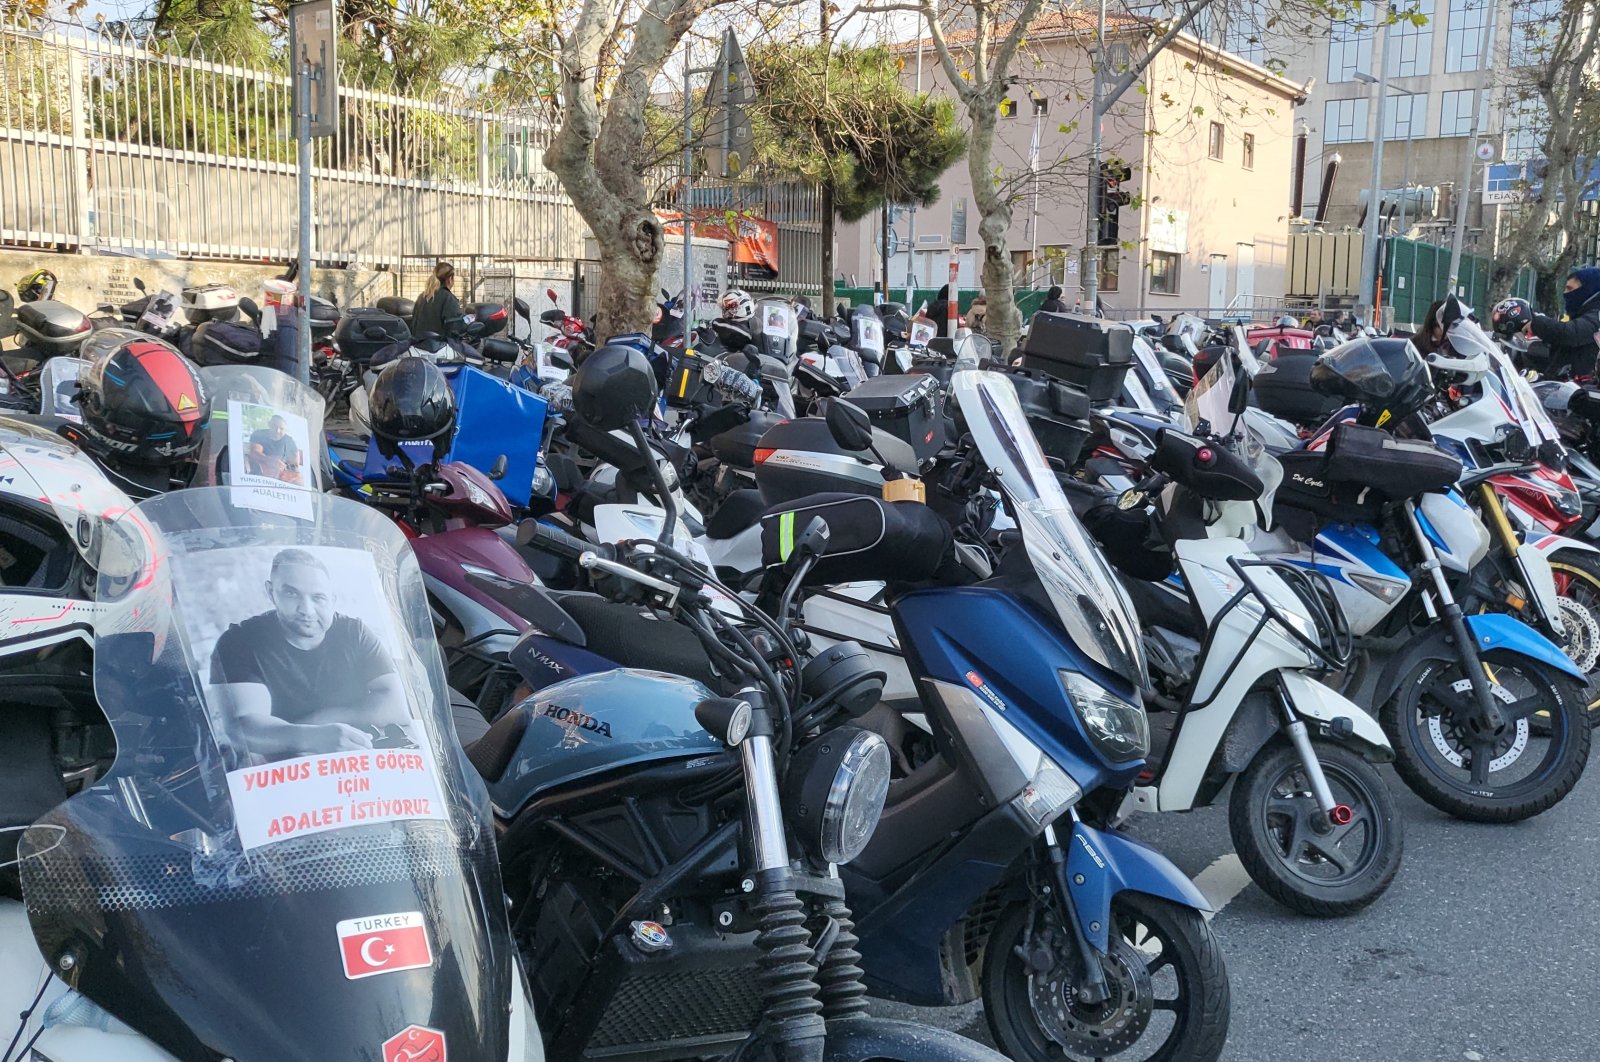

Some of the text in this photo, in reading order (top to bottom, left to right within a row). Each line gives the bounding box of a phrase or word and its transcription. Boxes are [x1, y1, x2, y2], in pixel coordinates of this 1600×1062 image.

[528, 647, 564, 674] NMAX
[543, 704, 613, 738] HONDA
[243, 751, 425, 791] YUNUS EMRE GÖÇER
[337, 775, 370, 798] İÇİN
[267, 797, 431, 838] ADALET İSTİYORUZ
[1075, 834, 1105, 869] ABS
[354, 915, 410, 932] TURKEY
